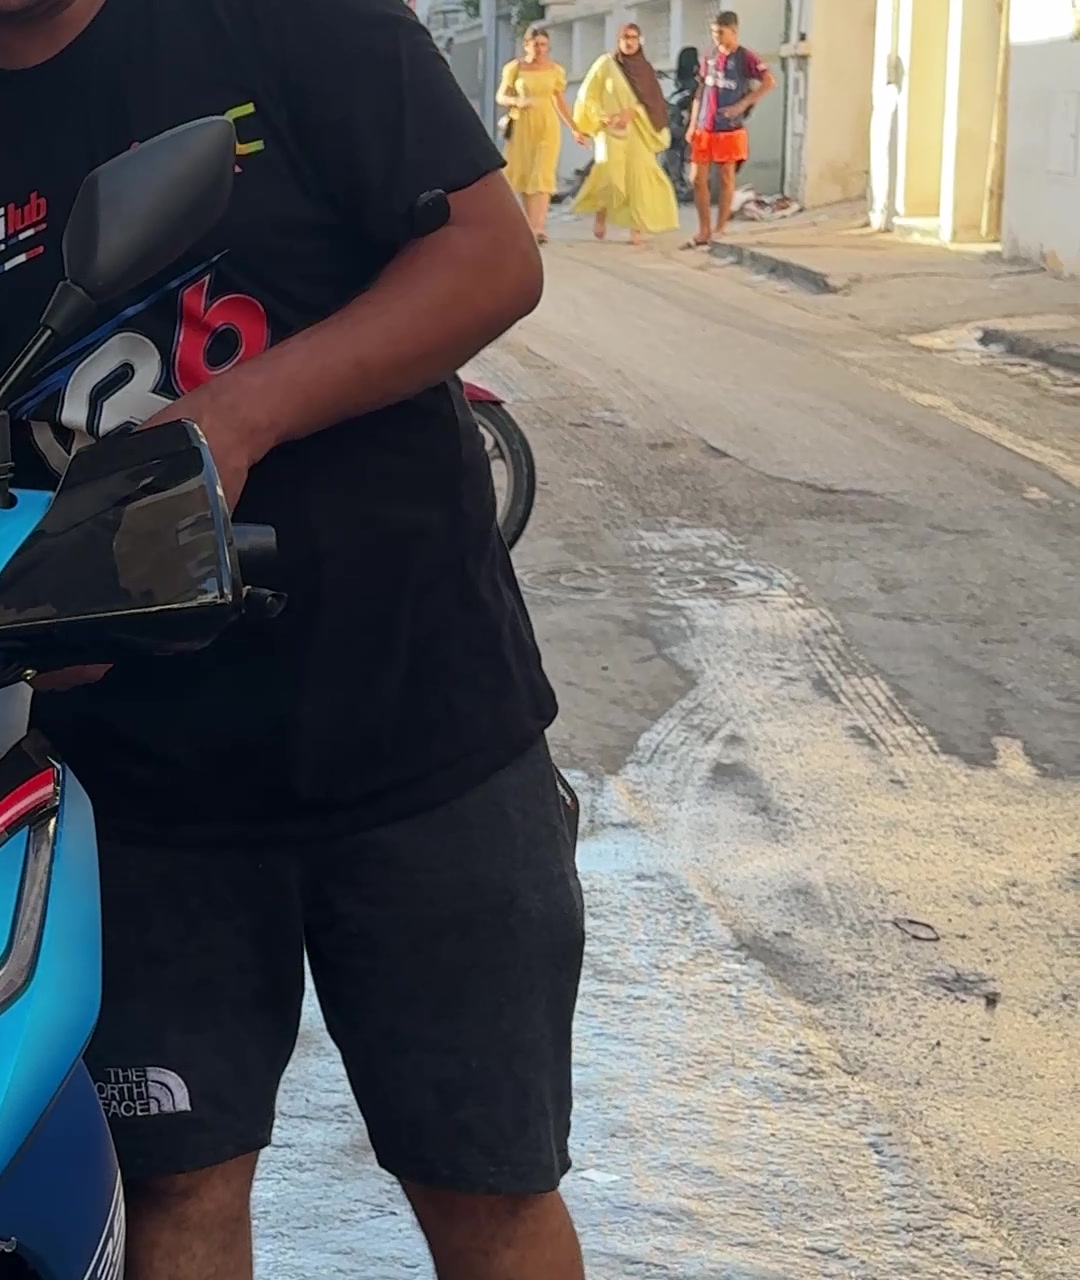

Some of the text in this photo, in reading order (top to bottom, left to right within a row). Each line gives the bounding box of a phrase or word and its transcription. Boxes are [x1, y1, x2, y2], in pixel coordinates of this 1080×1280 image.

[104, 1067, 146, 1083] THE
[94, 1081, 148, 1101] ORTH
[99, 1099, 150, 1118] FACE
